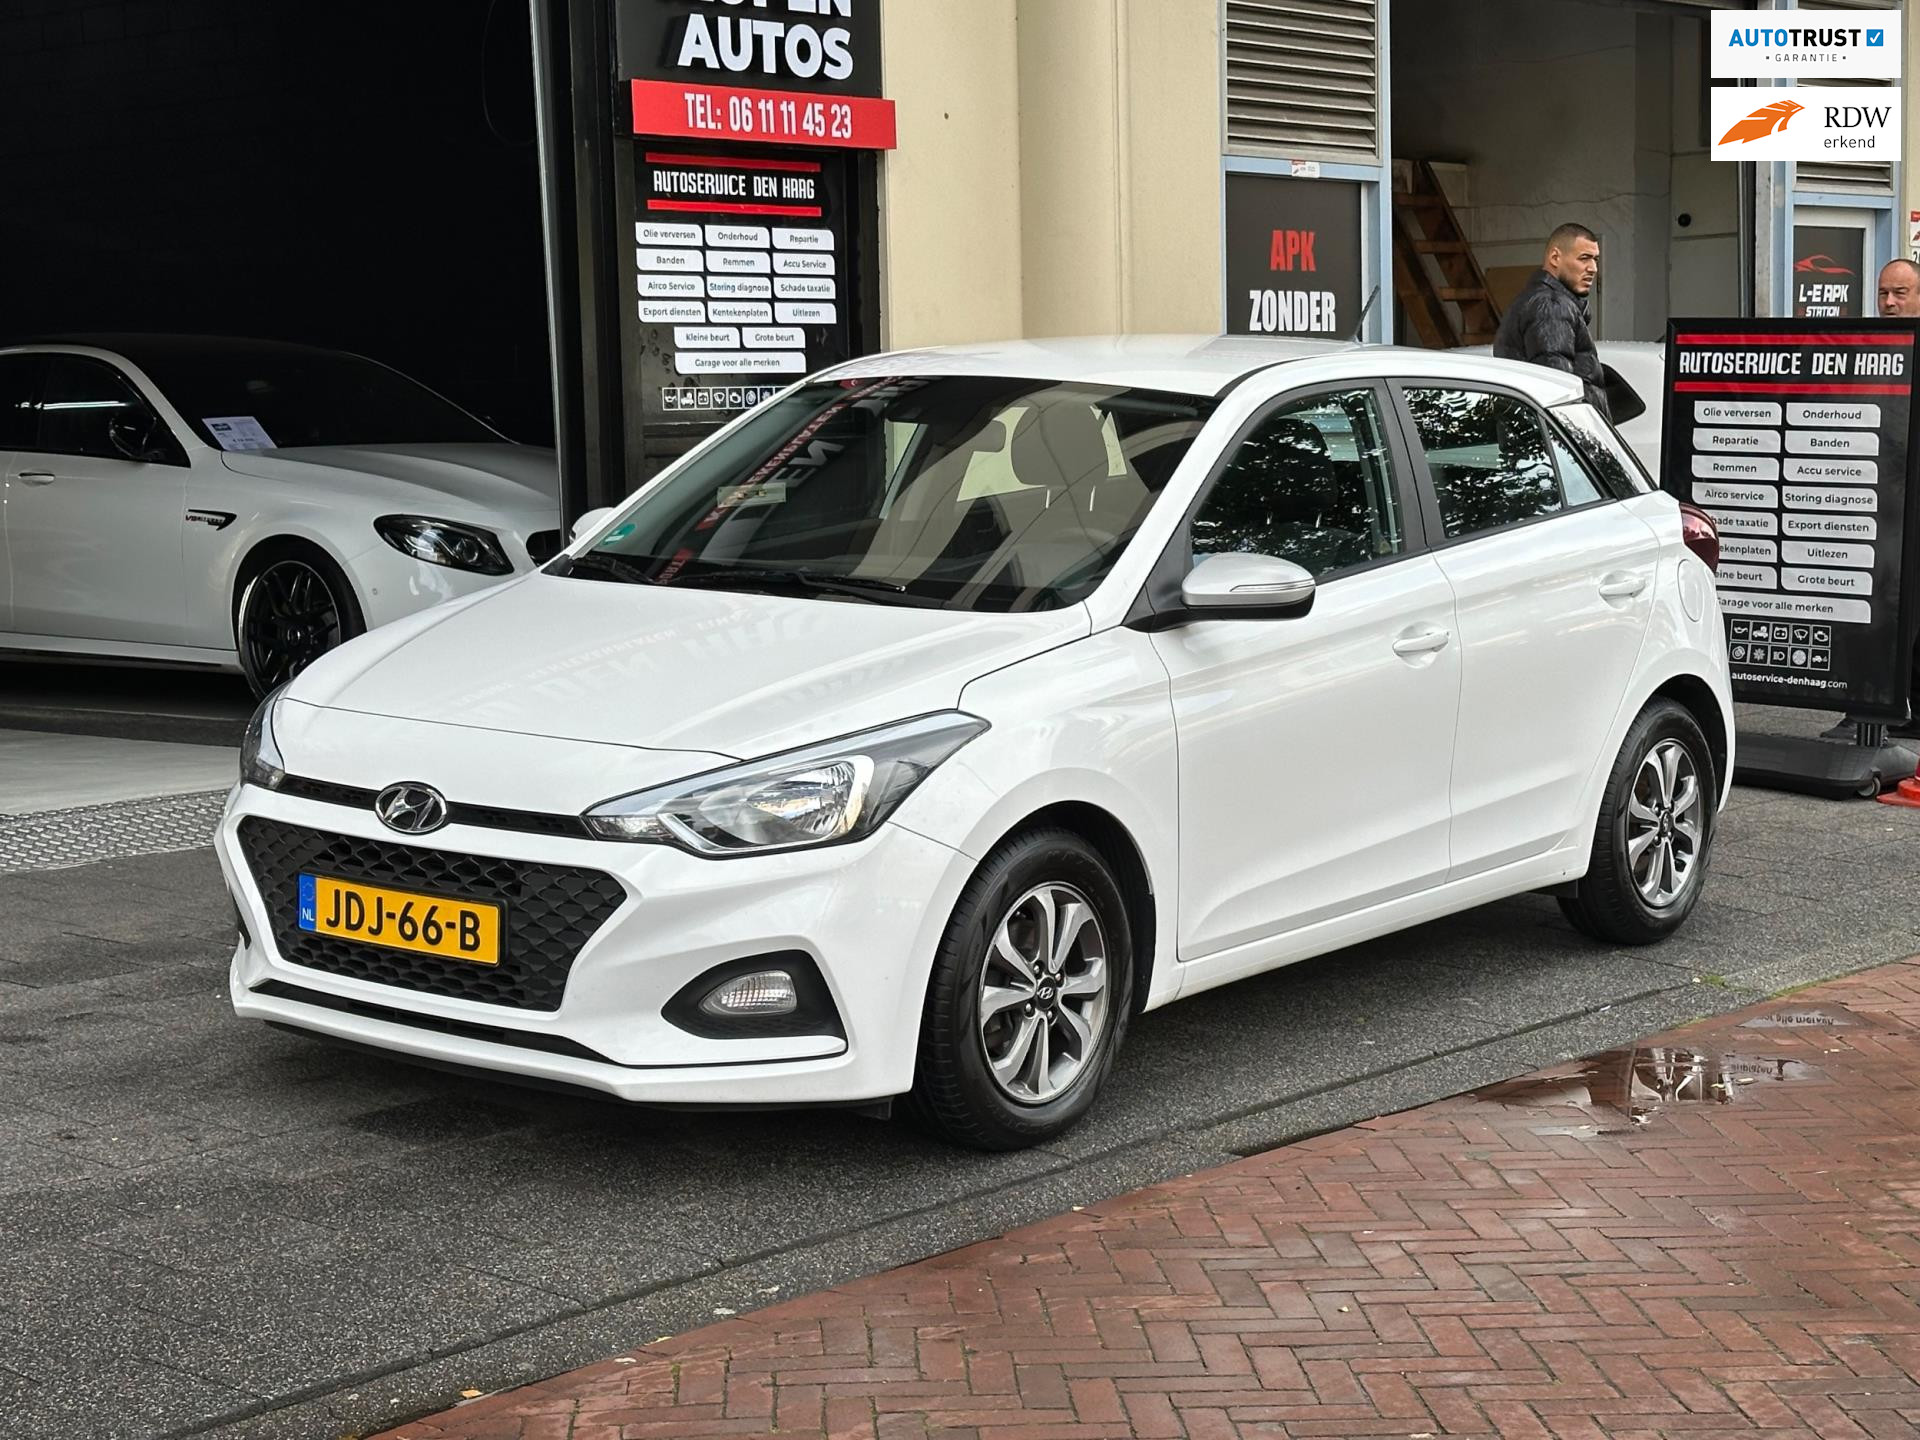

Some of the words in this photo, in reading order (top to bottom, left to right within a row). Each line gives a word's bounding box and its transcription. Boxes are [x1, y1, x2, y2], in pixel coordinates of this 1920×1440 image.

[678, 14, 854, 80] AUTOS
[685, 92, 721, 130] TEL:
[729, 96, 752, 132] 06
[758, 98, 774, 134] 11
[780, 100, 796, 135] 11
[803, 102, 825, 138] 45
[830, 104, 852, 139] 23
[654, 170, 746, 196] AUTOSERVICE
[754, 176, 778, 197] DEN
[782, 179, 814, 199] HAAG
[643, 229, 658, 238] Olie
[718, 232, 758, 241] Onderhoud
[1270, 229, 1316, 272] APK
[657, 256, 685, 264] Banden
[723, 258, 755, 266] Remmen
[784, 260, 800, 268] Accu
[802, 260, 826, 268] Service
[648, 282, 667, 290] Airco
[710, 283, 735, 292] Storing
[737, 283, 769, 293] diagnose
[781, 284, 806, 292] Schade
[1823, 284, 1849, 302] APK
[643, 308, 667, 317] Export
[670, 308, 701, 316] diensten
[713, 309, 768, 318] Kentekenplaten
[793, 309, 820, 317] Uitlezen
[1249, 290, 1336, 331] ZONDER
[687, 334, 708, 342] Kleine
[710, 334, 729, 342] beurt
[755, 334, 774, 342] Grote
[776, 334, 794, 342] beurt
[695, 359, 720, 368] Garage
[754, 359, 780, 367] merken
[1680, 352, 1801, 374] AUTOSERVICE
[1812, 352, 1847, 375] DEN
[1854, 353, 1904, 375] HAAG
[1704, 408, 1721, 416] Olie
[1725, 410, 1771, 418] verversen
[1803, 410, 1861, 419] Onderhoud
[1713, 436, 1759, 447] Reparatie
[1810, 439, 1849, 448] Banden
[1713, 464, 1756, 472] Remmen
[1798, 466, 1822, 475] Accu
[1825, 467, 1862, 476] service
[1705, 490, 1728, 499] Airco
[1730, 492, 1764, 500] service
[1785, 493, 1821, 504] Storing
[1825, 494, 1873, 505] diagnose
[1713, 517, 1733, 525] hade
[1736, 519, 1768, 527] taxatie
[1788, 521, 1821, 531] Export
[1824, 522, 1869, 532] diensten
[1808, 549, 1847, 559] Uitlezen
[1715, 571, 1734, 579] eine
[1737, 572, 1763, 581] beurt
[1798, 575, 1825, 584] Grote
[1828, 576, 1855, 586] beurt
[1775, 601, 1792, 610] alle
[1795, 604, 1833, 613] merken
[1732, 672, 1847, 689] autoservice-denhaag.com
[302, 908, 314, 921] NL
[326, 889, 481, 952] JDJ-66-B
